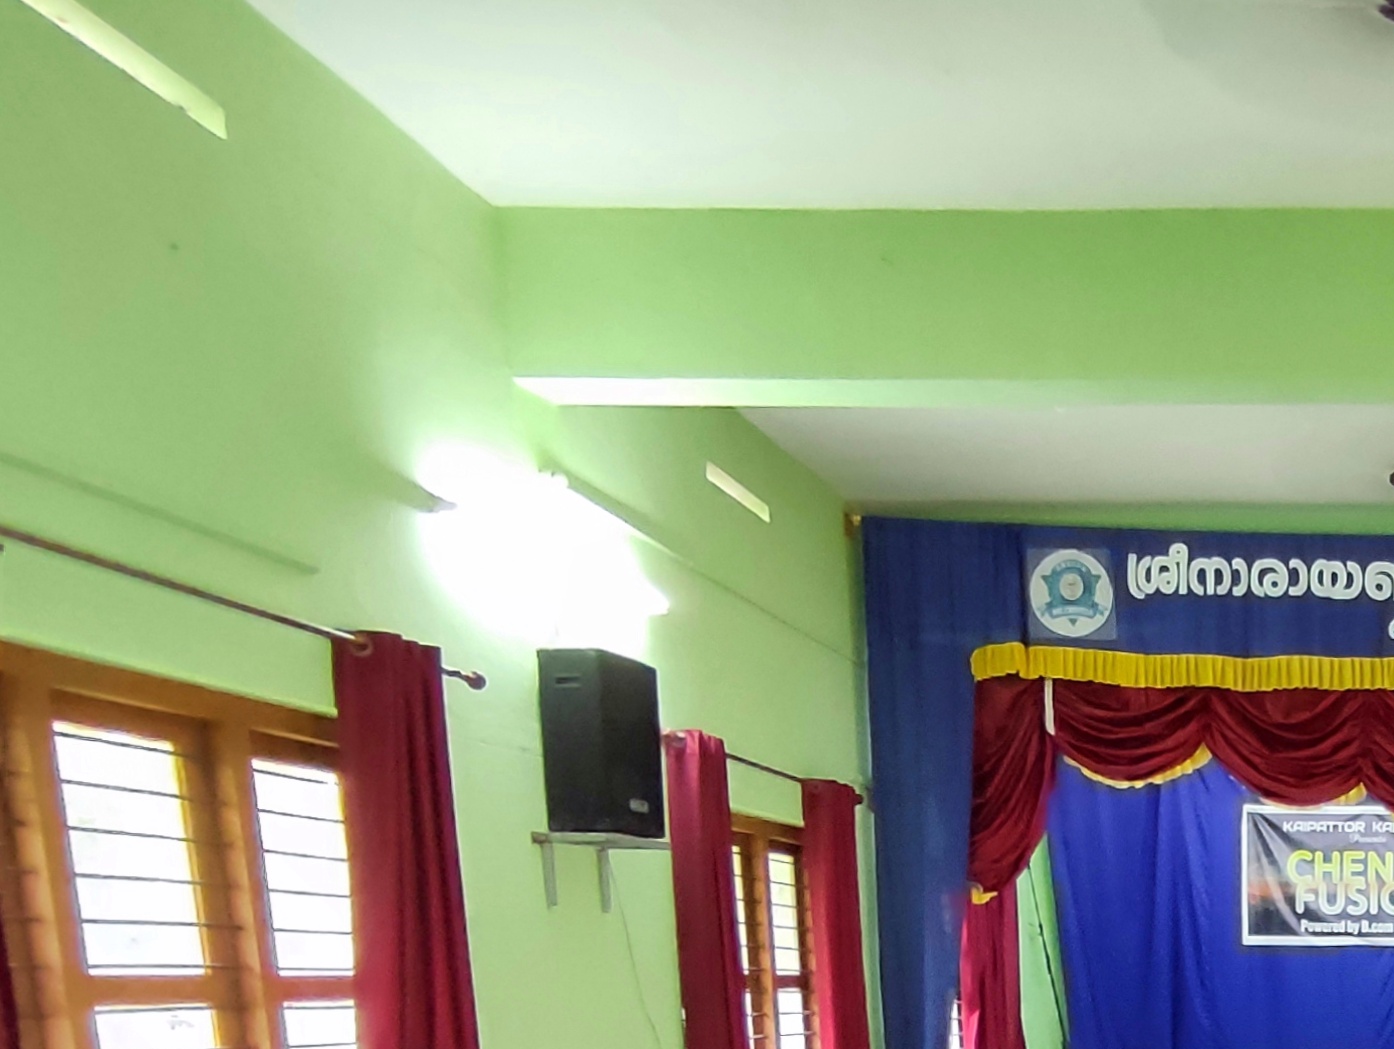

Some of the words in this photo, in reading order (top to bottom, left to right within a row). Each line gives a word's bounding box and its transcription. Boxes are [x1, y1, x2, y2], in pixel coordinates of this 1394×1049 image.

[1283, 821, 1366, 833] KAIPATTOR
[1301, 919, 1345, 933] Powered
[1346, 920, 1360, 935] by
